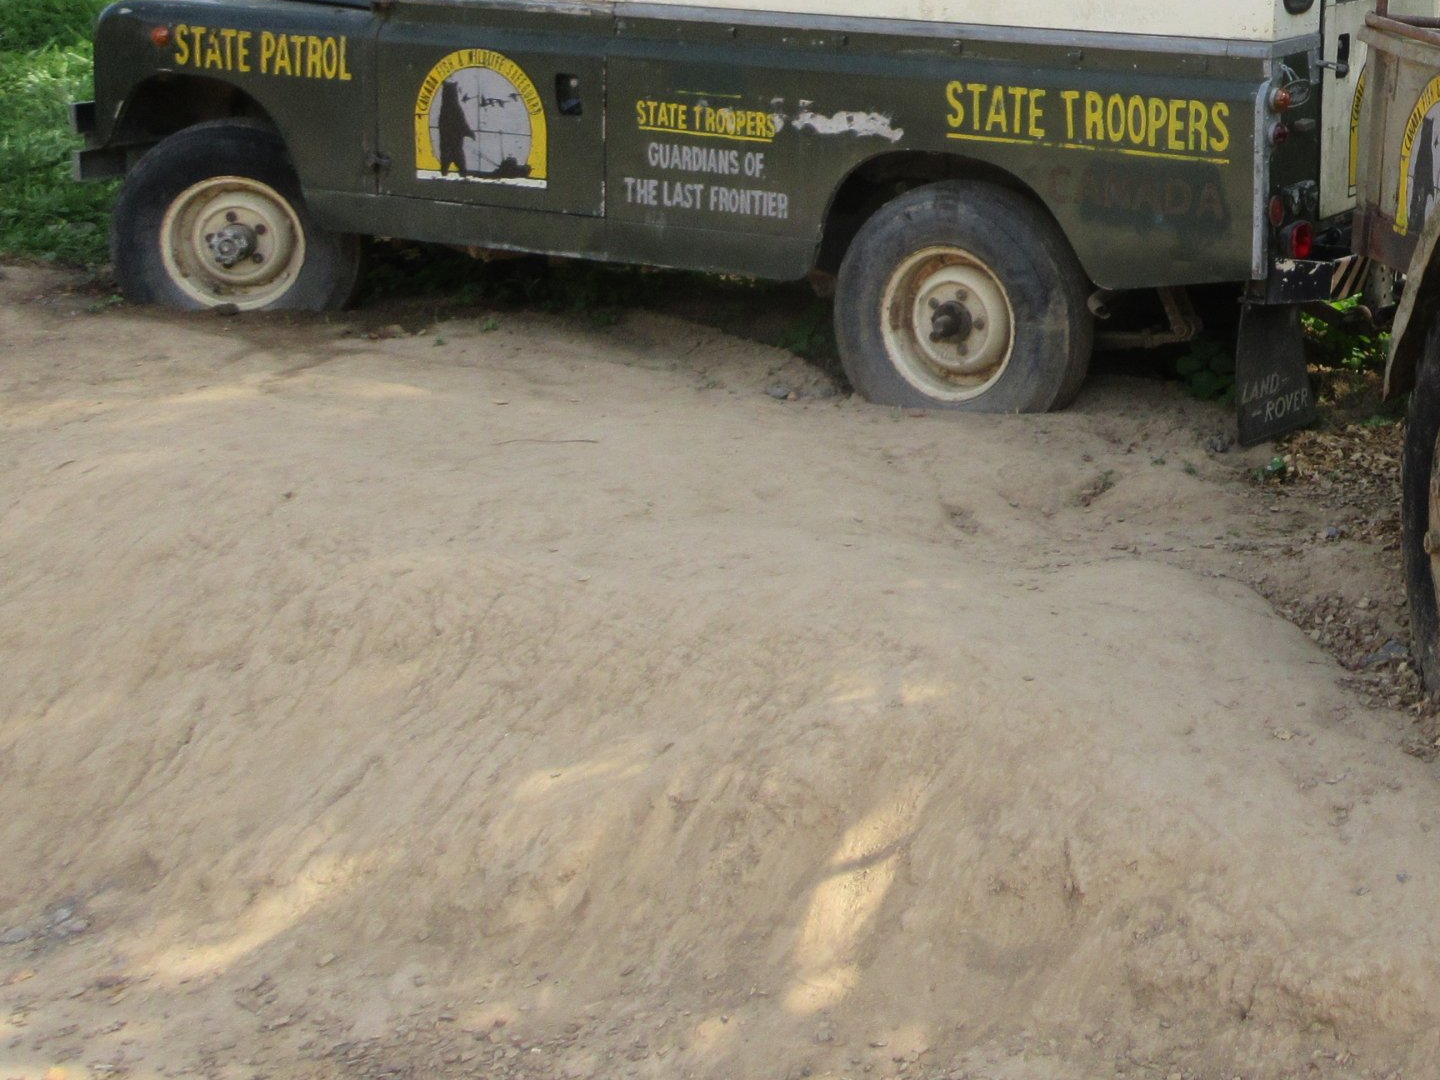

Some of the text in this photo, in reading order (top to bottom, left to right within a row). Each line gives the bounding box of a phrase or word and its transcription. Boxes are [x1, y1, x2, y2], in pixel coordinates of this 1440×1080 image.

[174, 24, 352, 81] STATE PATROL
[636, 99, 777, 139] STATE TROOPERS
[946, 80, 1230, 153] STATE TROOPERS
[648, 141, 764, 179] GUARDIANS OF
[624, 177, 789, 220] THE LAST FRONTIER
